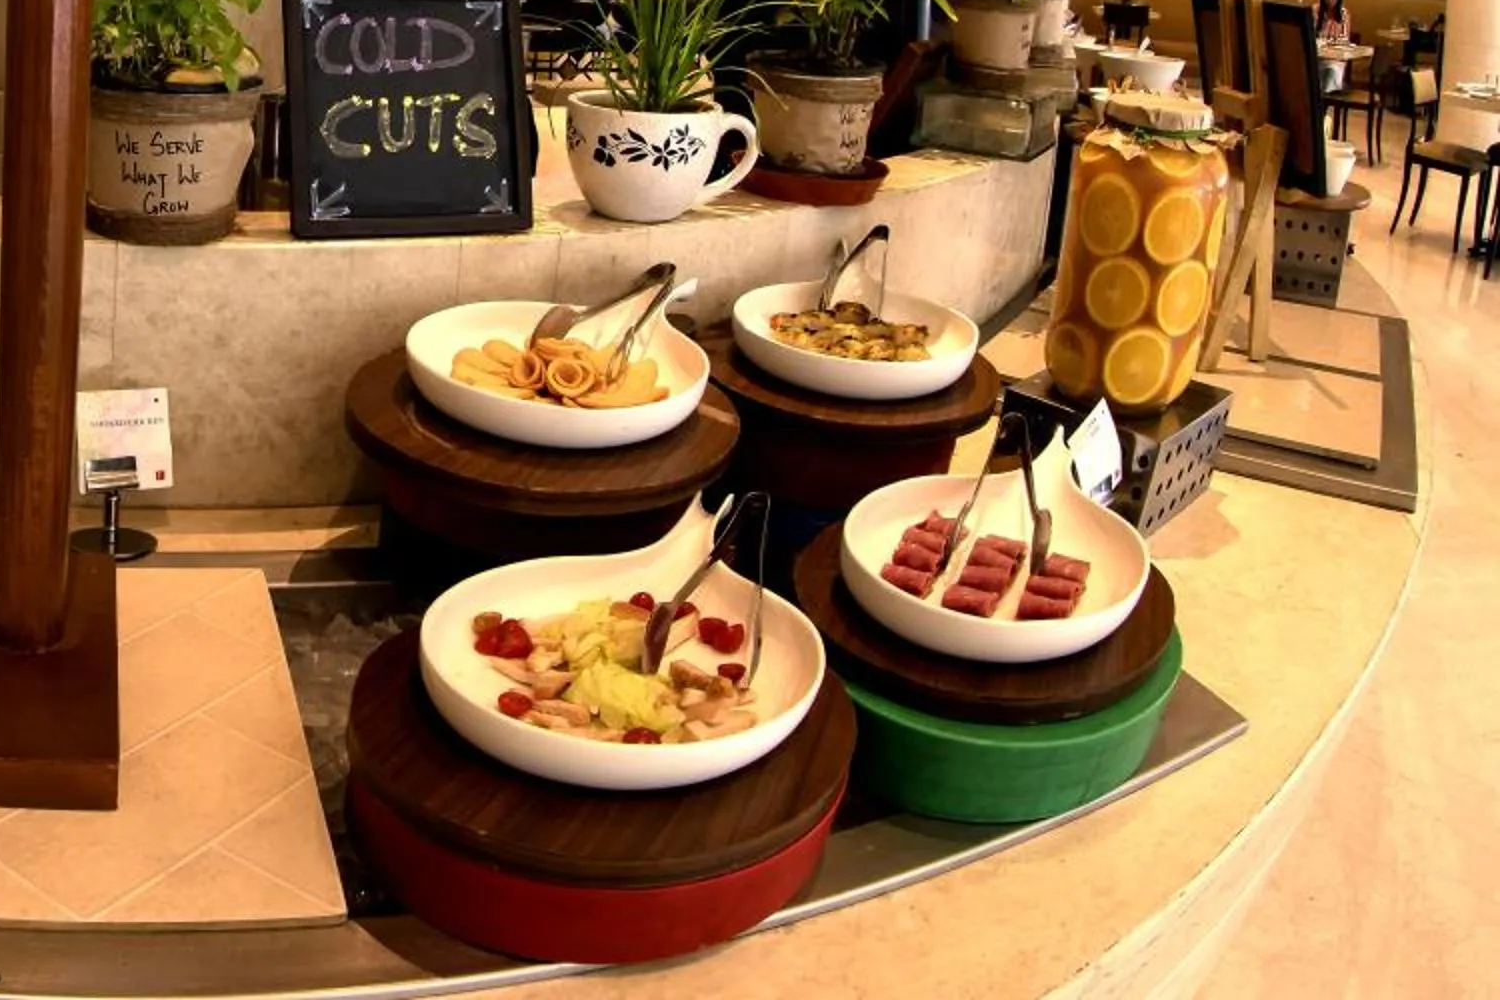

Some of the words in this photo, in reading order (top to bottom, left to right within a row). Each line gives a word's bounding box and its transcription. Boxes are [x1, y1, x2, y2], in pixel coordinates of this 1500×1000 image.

[315, 12, 476, 77] COLD
[115, 130, 140, 155] WE
[149, 131, 205, 157] SERVE
[320, 92, 497, 160] CUTS
[121, 161, 169, 198] WHAT
[178, 163, 202, 185] WE
[143, 191, 189, 215] GROW
